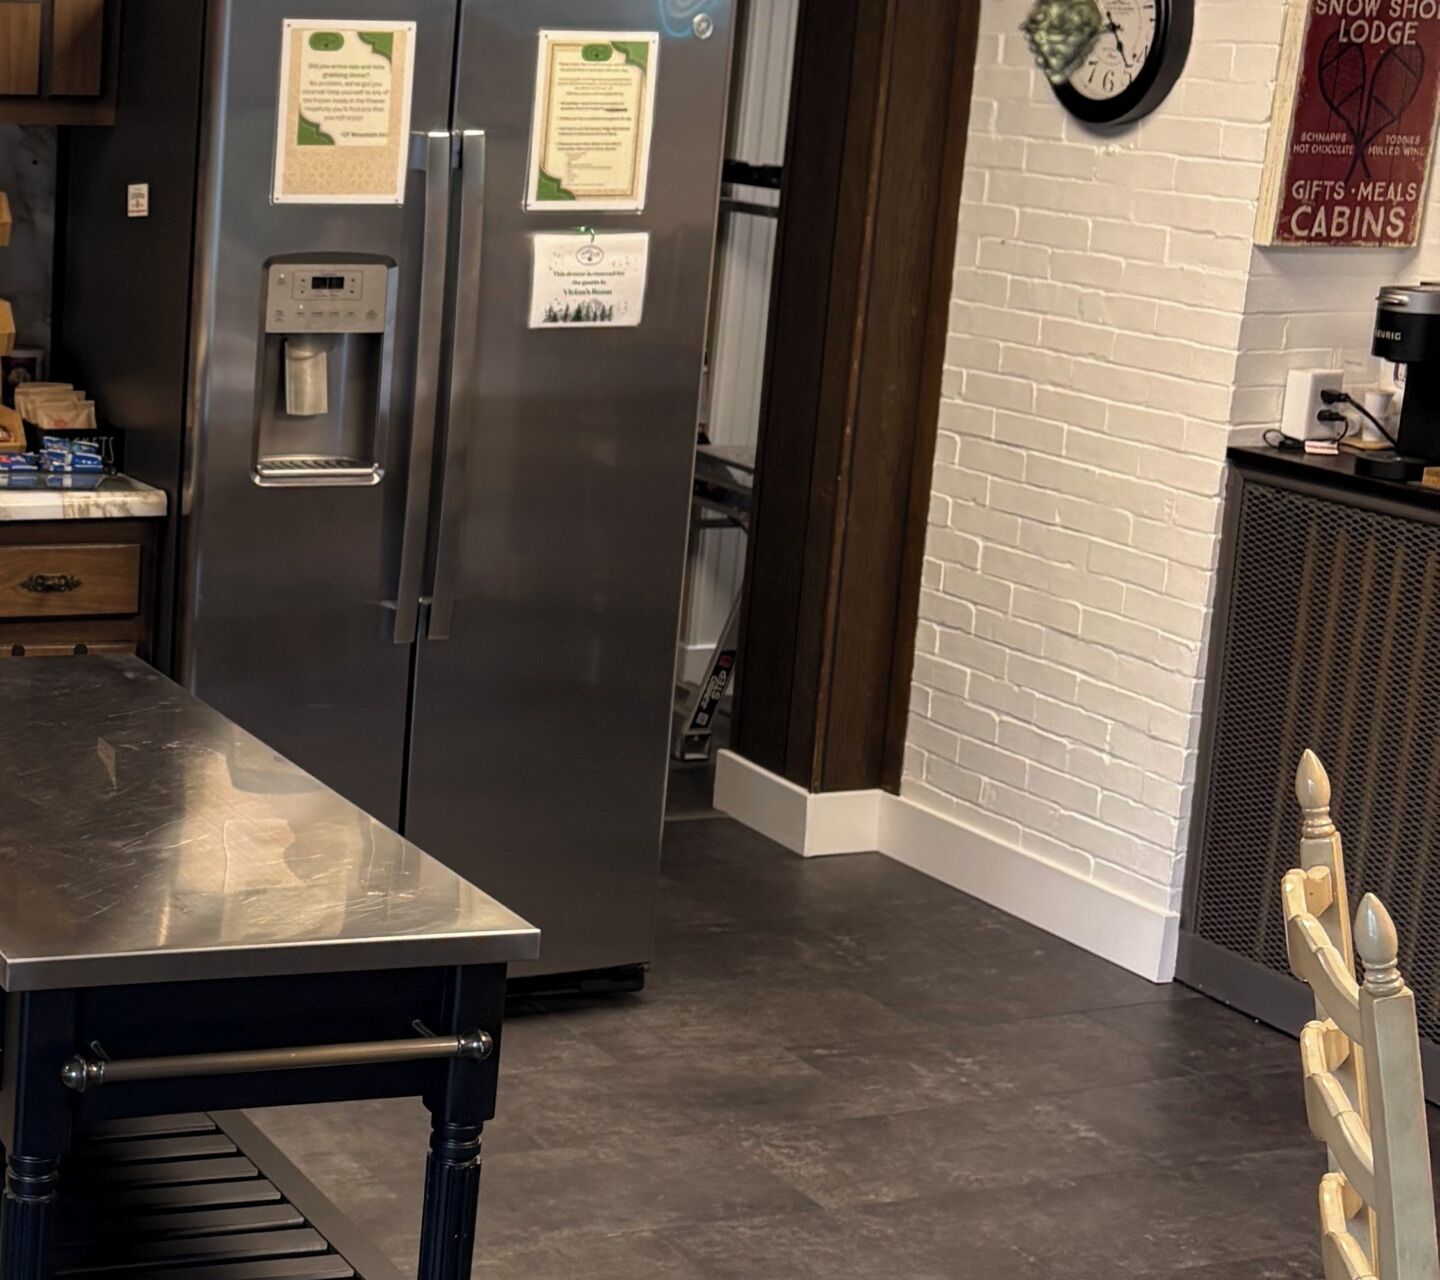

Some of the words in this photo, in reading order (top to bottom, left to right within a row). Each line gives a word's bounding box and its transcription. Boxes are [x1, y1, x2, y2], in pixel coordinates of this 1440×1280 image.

[1338, 19, 1419, 46] LODGE
[1102, 71, 1115, 93] 6
[1300, 131, 1348, 143] SCHNAPPS
[1293, 144, 1310, 154] HOT
[1291, 180, 1345, 201] GIFTS
[1357, 181, 1417, 202] MEALS
[1290, 205, 1406, 238] CABINS
